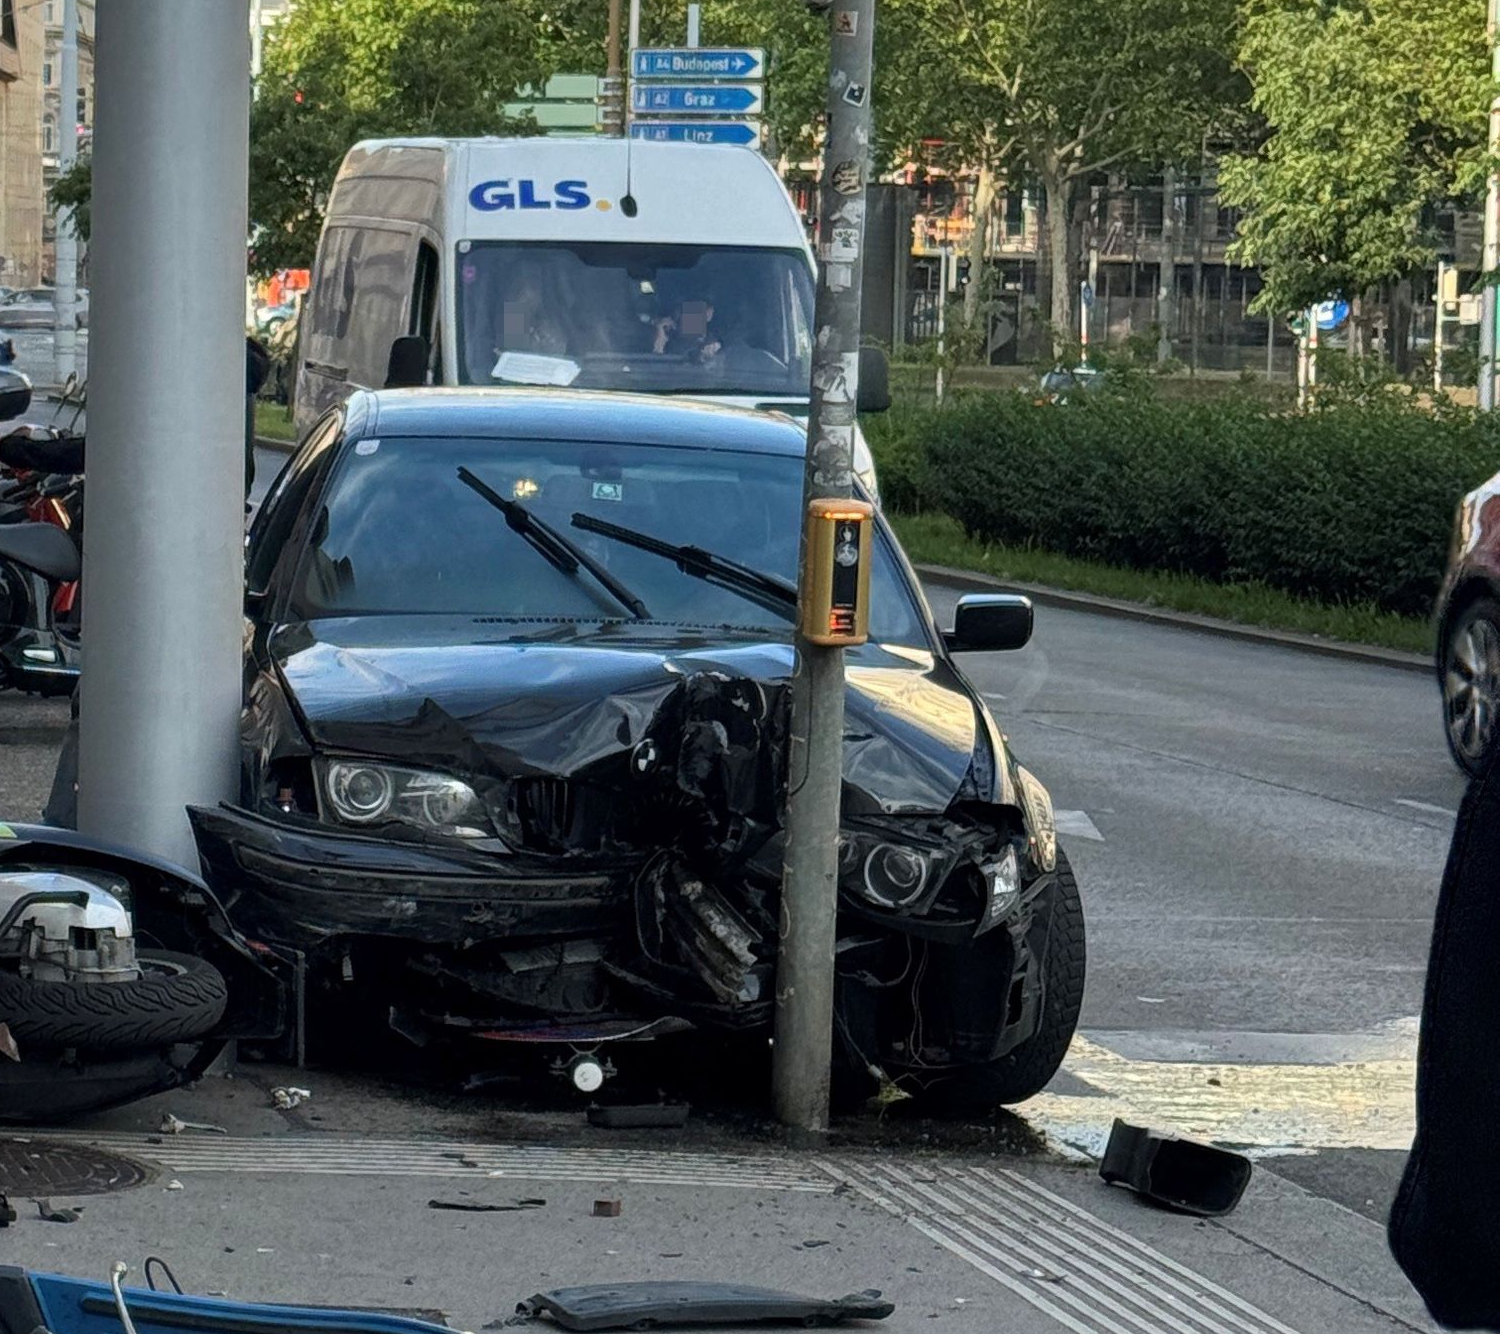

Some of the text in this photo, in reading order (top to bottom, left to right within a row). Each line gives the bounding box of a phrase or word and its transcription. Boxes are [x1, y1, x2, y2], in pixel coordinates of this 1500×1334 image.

[673, 56, 729, 71] Budapest
[654, 92, 715, 106] A2 Graz
[684, 129, 714, 142] Linz
